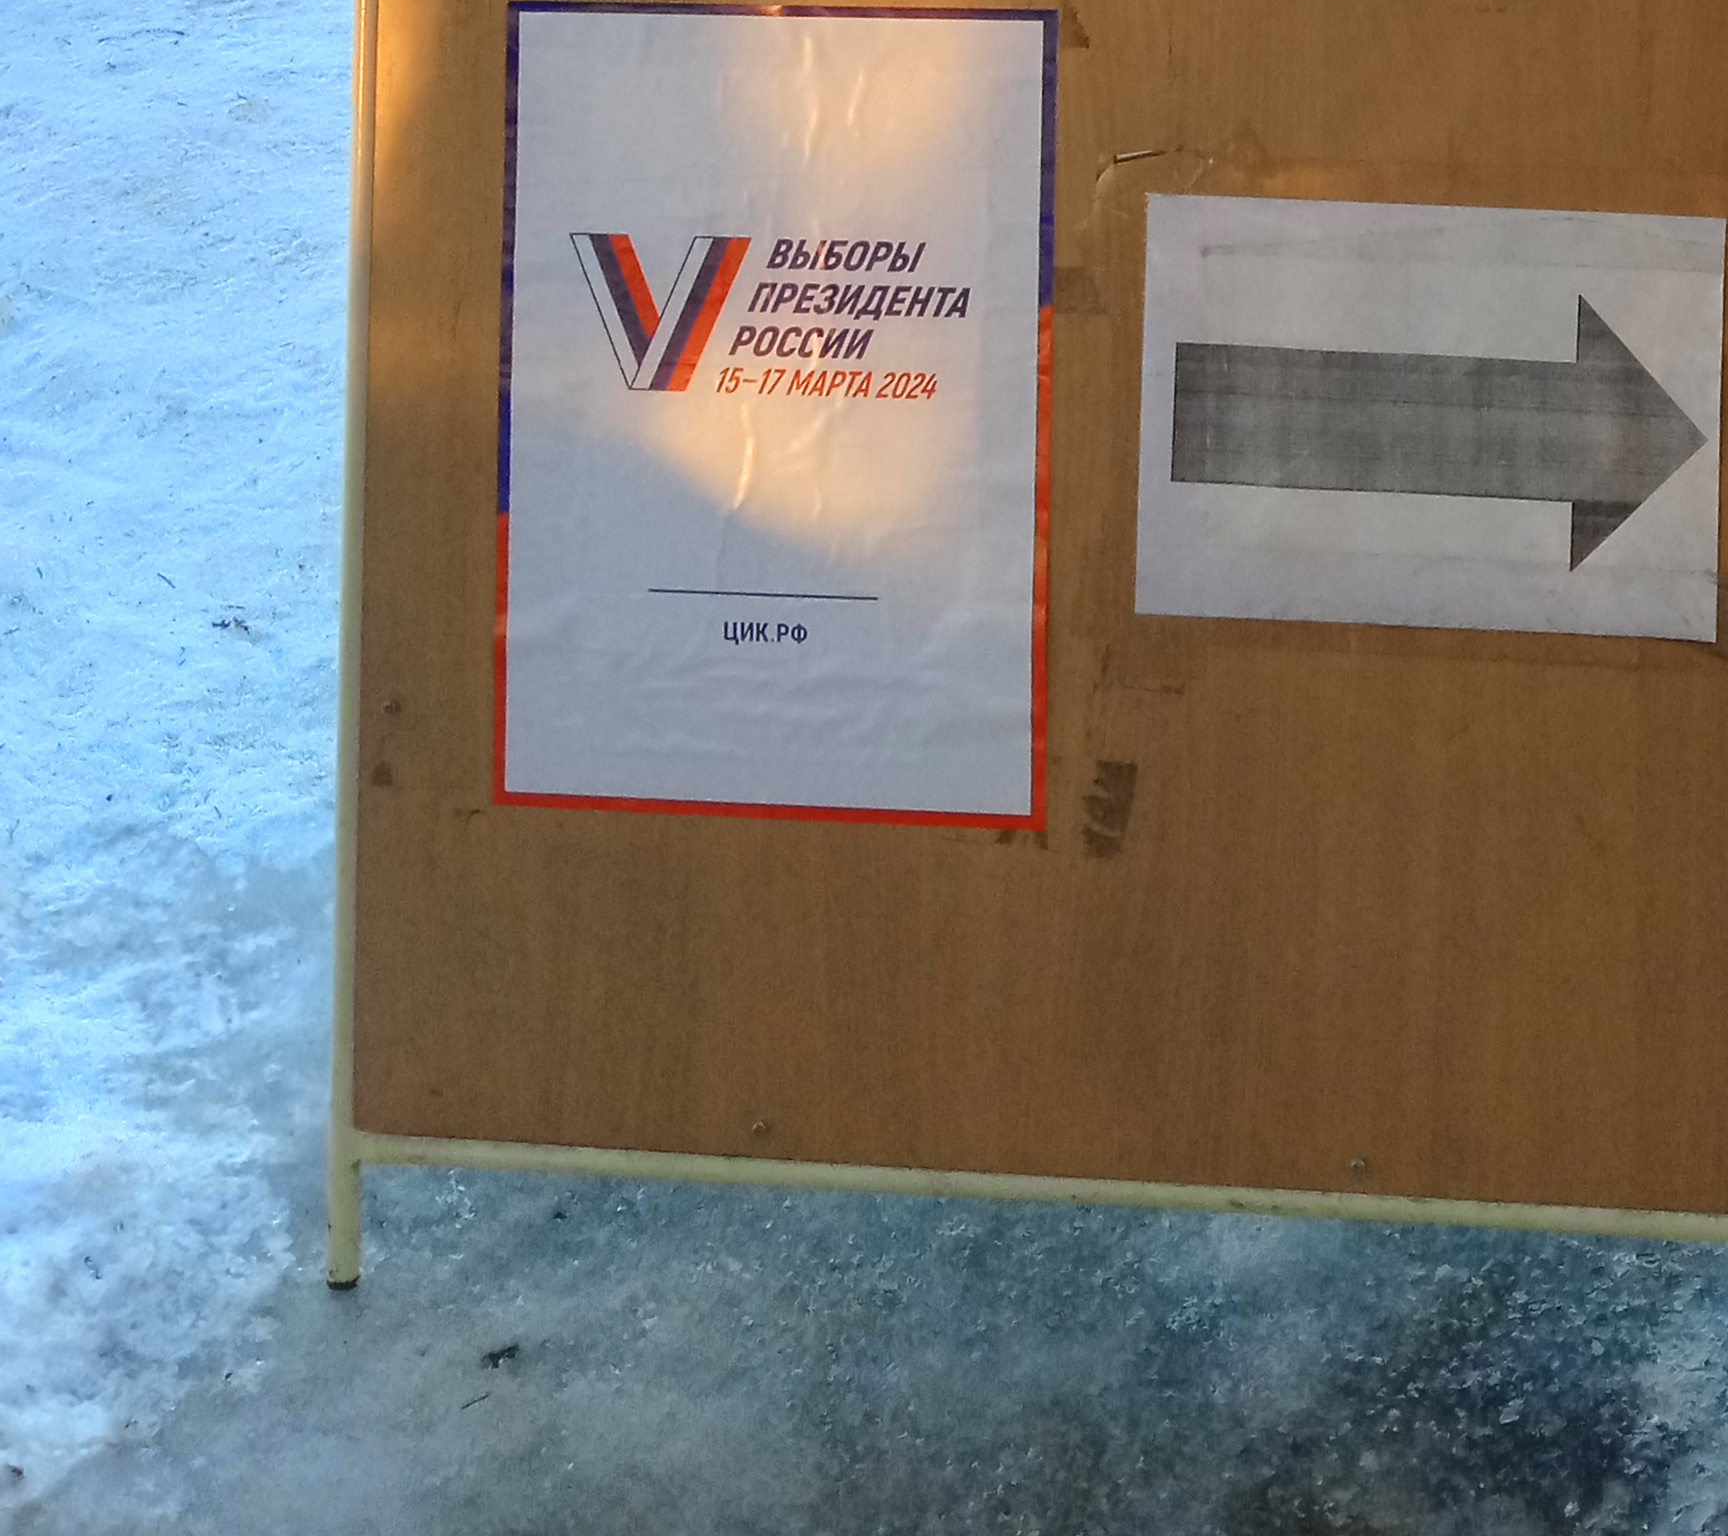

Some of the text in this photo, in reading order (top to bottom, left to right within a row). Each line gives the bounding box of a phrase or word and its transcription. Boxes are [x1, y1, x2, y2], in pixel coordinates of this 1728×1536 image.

[766, 237, 927, 274] ВЫБОРЫ
[746, 281, 972, 322] ПРЕЗИДЕНТА
[728, 325, 873, 361] РОССИИ
[785, 368, 874, 400] МАРТА
[874, 371, 938, 402] 2024
[722, 619, 809, 645] ЦИК.РФ
